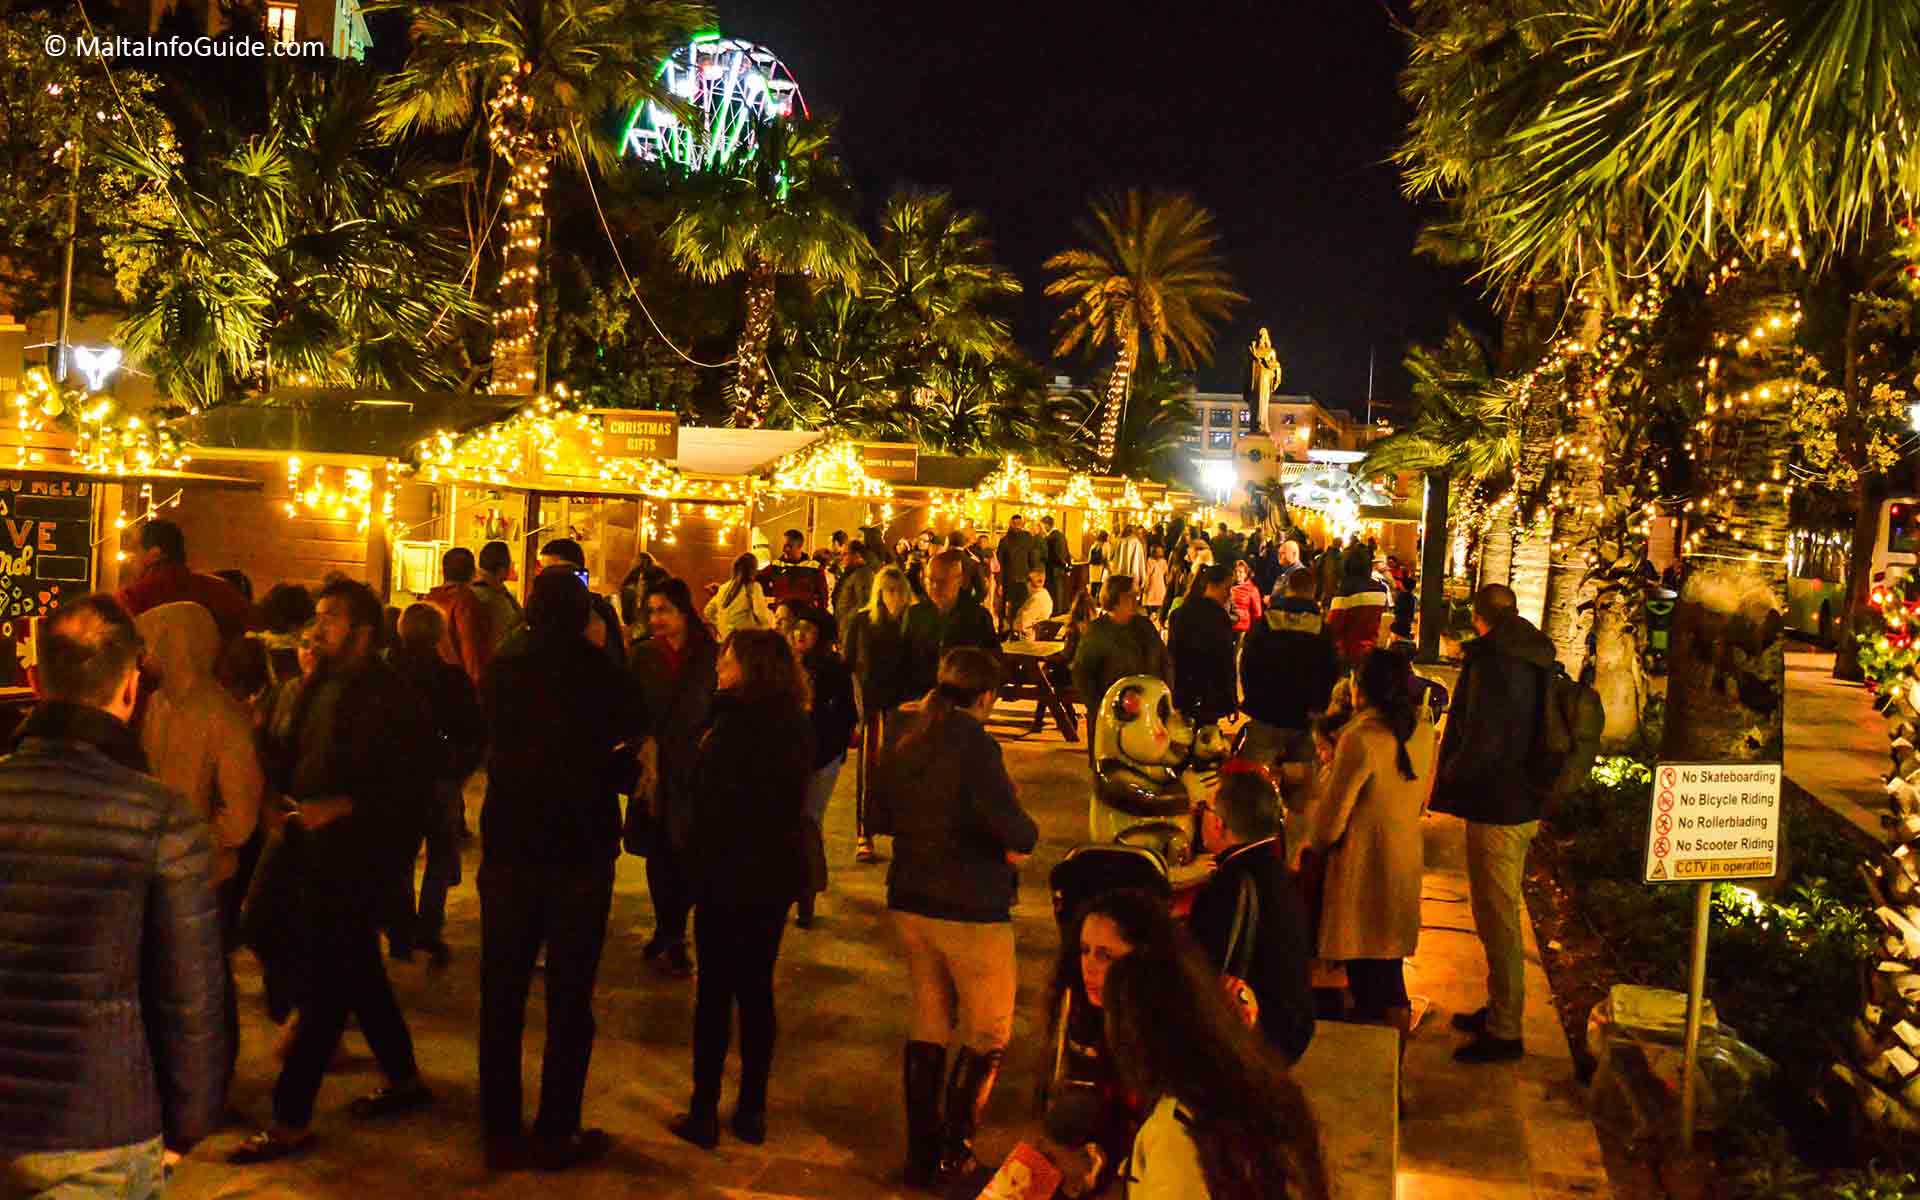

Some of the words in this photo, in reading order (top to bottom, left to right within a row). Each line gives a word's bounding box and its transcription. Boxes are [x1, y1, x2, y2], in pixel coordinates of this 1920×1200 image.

[610, 421, 672, 436] CHRISTMAS
[627, 438, 656, 451] GIFTS
[1681, 771, 1697, 783] No
[1700, 770, 1776, 784] Skateboarding
[1680, 794, 1695, 806] No
[1699, 793, 1737, 808] Bicycle
[1741, 792, 1774, 807] Riding
[1678, 817, 1693, 829] No
[1697, 815, 1768, 829] Rollerblading
[1676, 840, 1692, 851] No
[1695, 839, 1738, 851] Scooter
[1741, 838, 1774, 852] Riding
[1675, 861, 1707, 873] CCTV
[1710, 861, 1720, 873] in
[1723, 861, 1771, 874] operation
